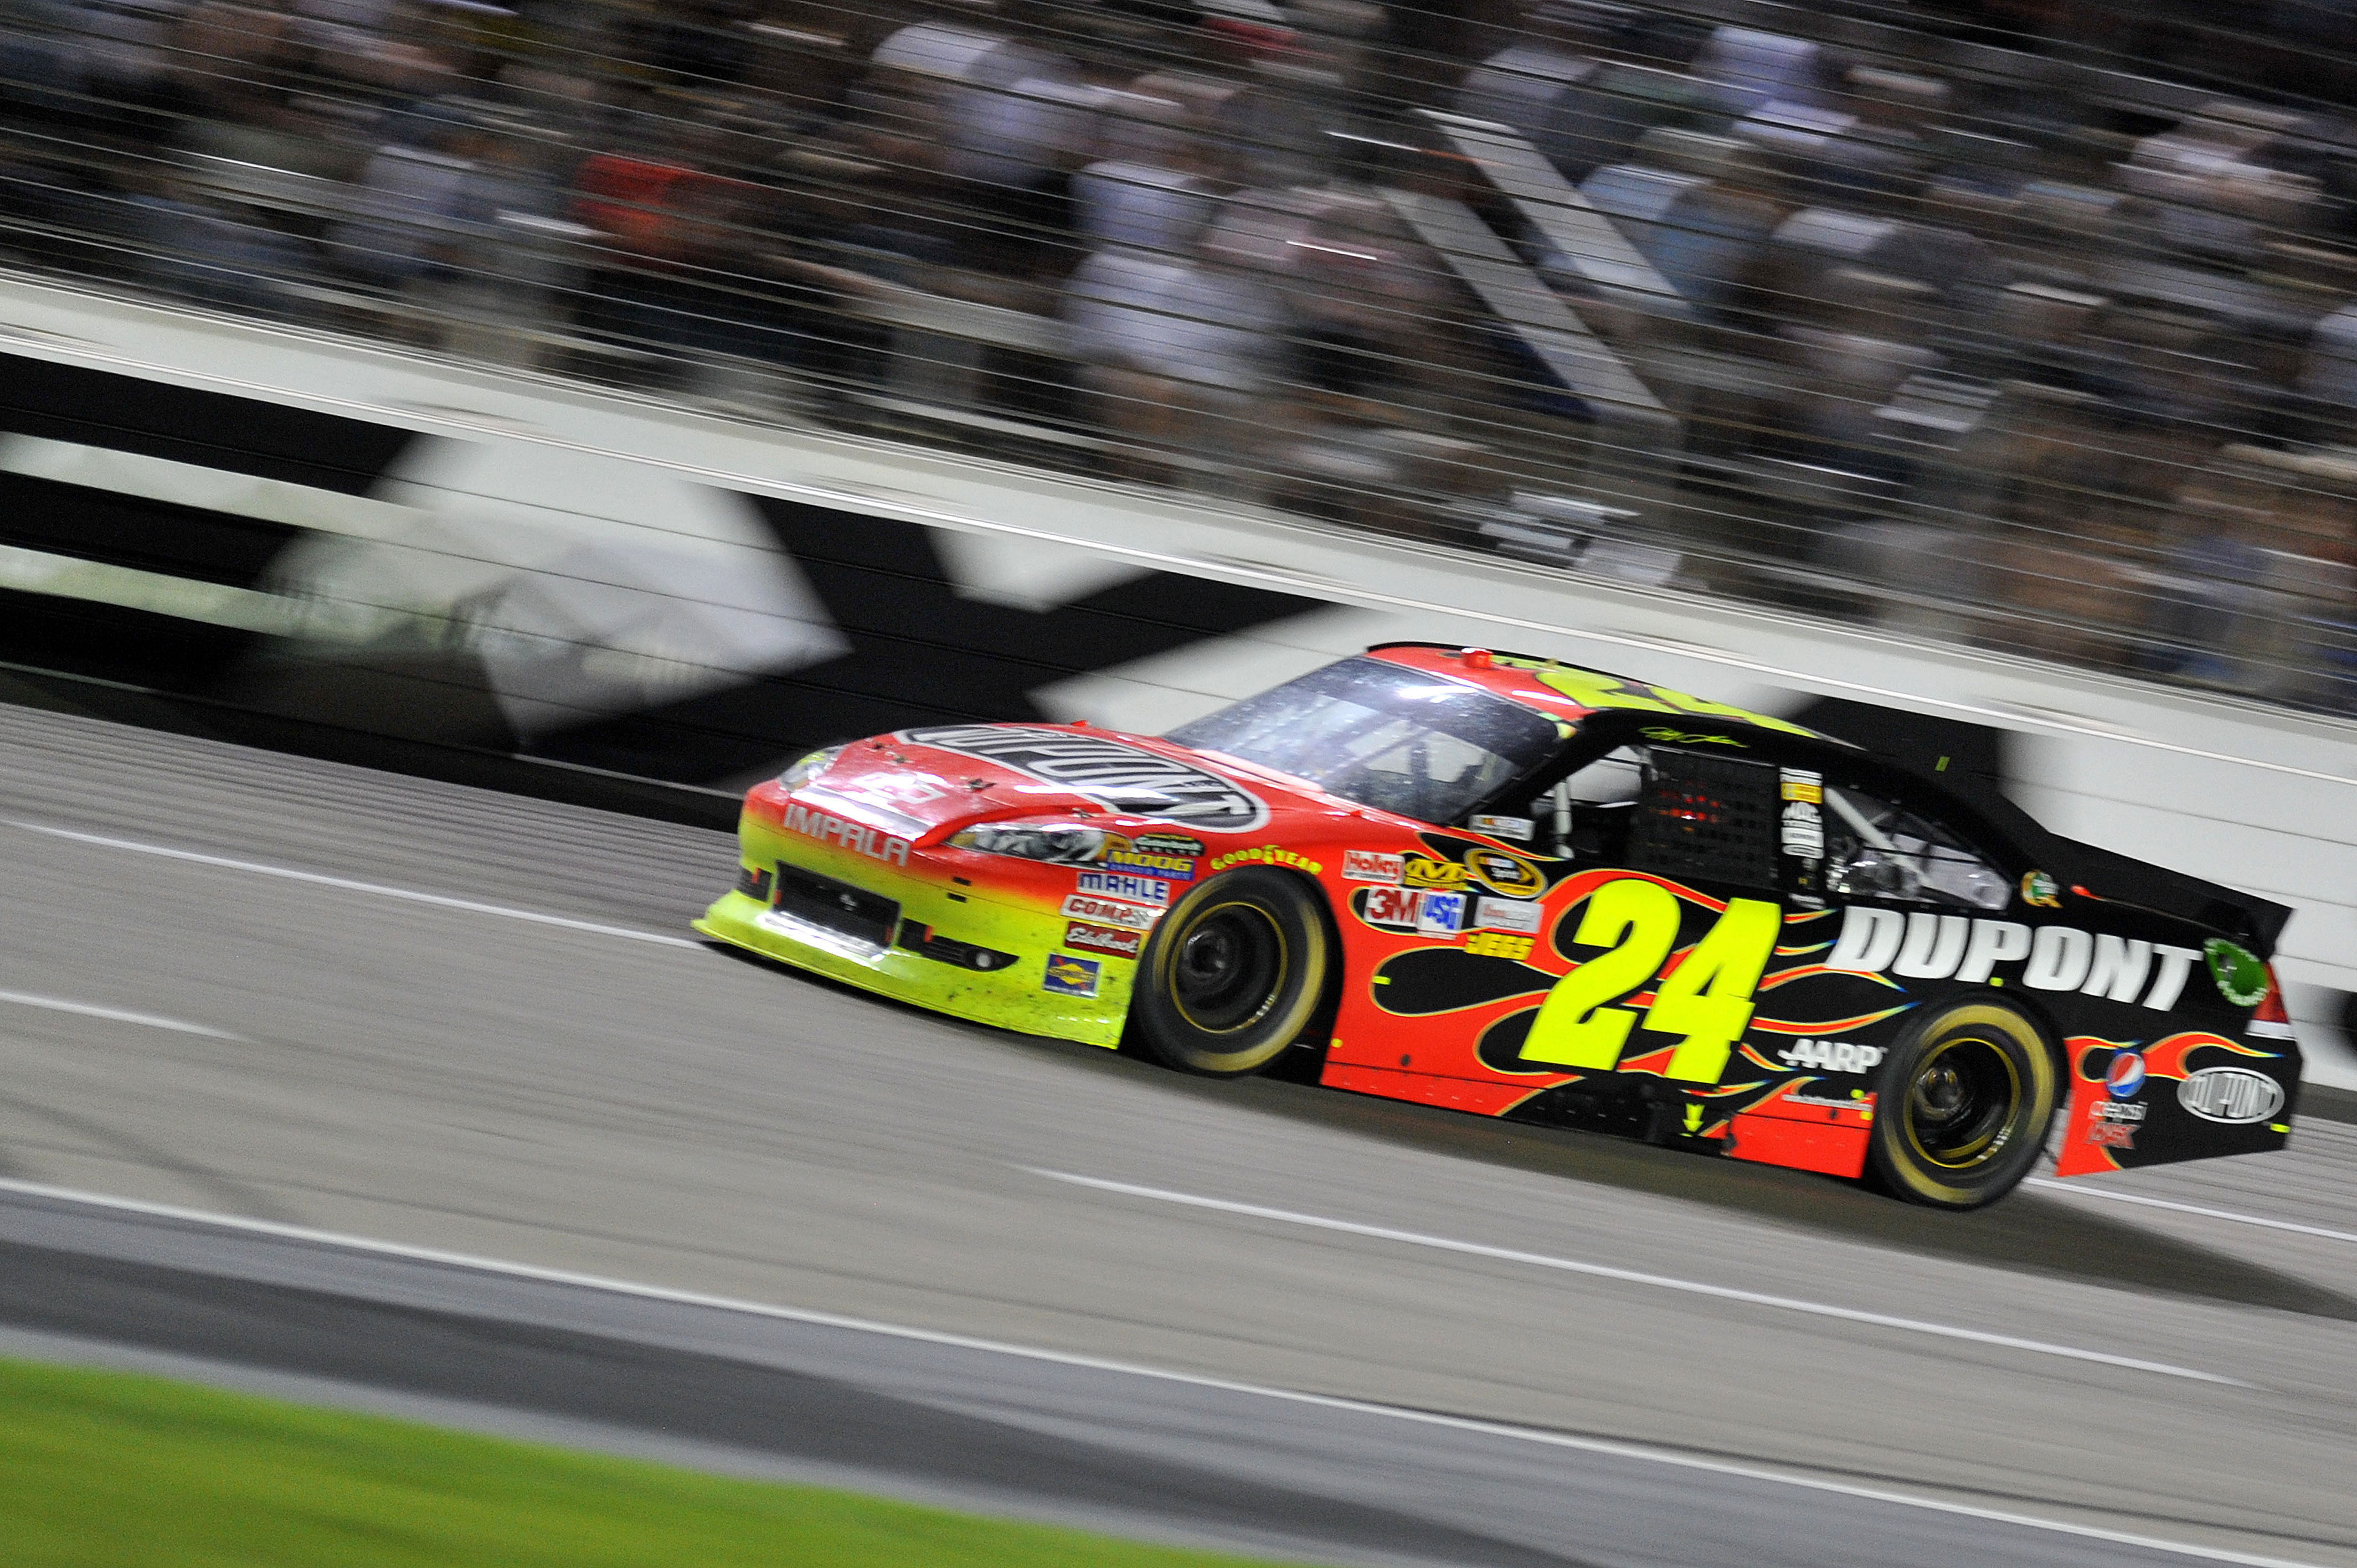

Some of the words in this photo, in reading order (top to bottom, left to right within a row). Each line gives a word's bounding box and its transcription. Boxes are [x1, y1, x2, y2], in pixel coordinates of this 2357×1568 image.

[784, 803, 910, 867] IMPALA
[1110, 851, 1193, 871] MOOG
[1210, 845, 1323, 875] GOODYEAR
[1079, 873, 1166, 900] MAHLE
[1068, 899, 1134, 920] COMP
[1371, 889, 1419, 923] 3M
[1826, 906, 2204, 1012] DUPONT
[1519, 878, 1781, 1085] 24
[1777, 1038, 1883, 1074] AARP
[2088, 1100, 2149, 1121] pepsi
